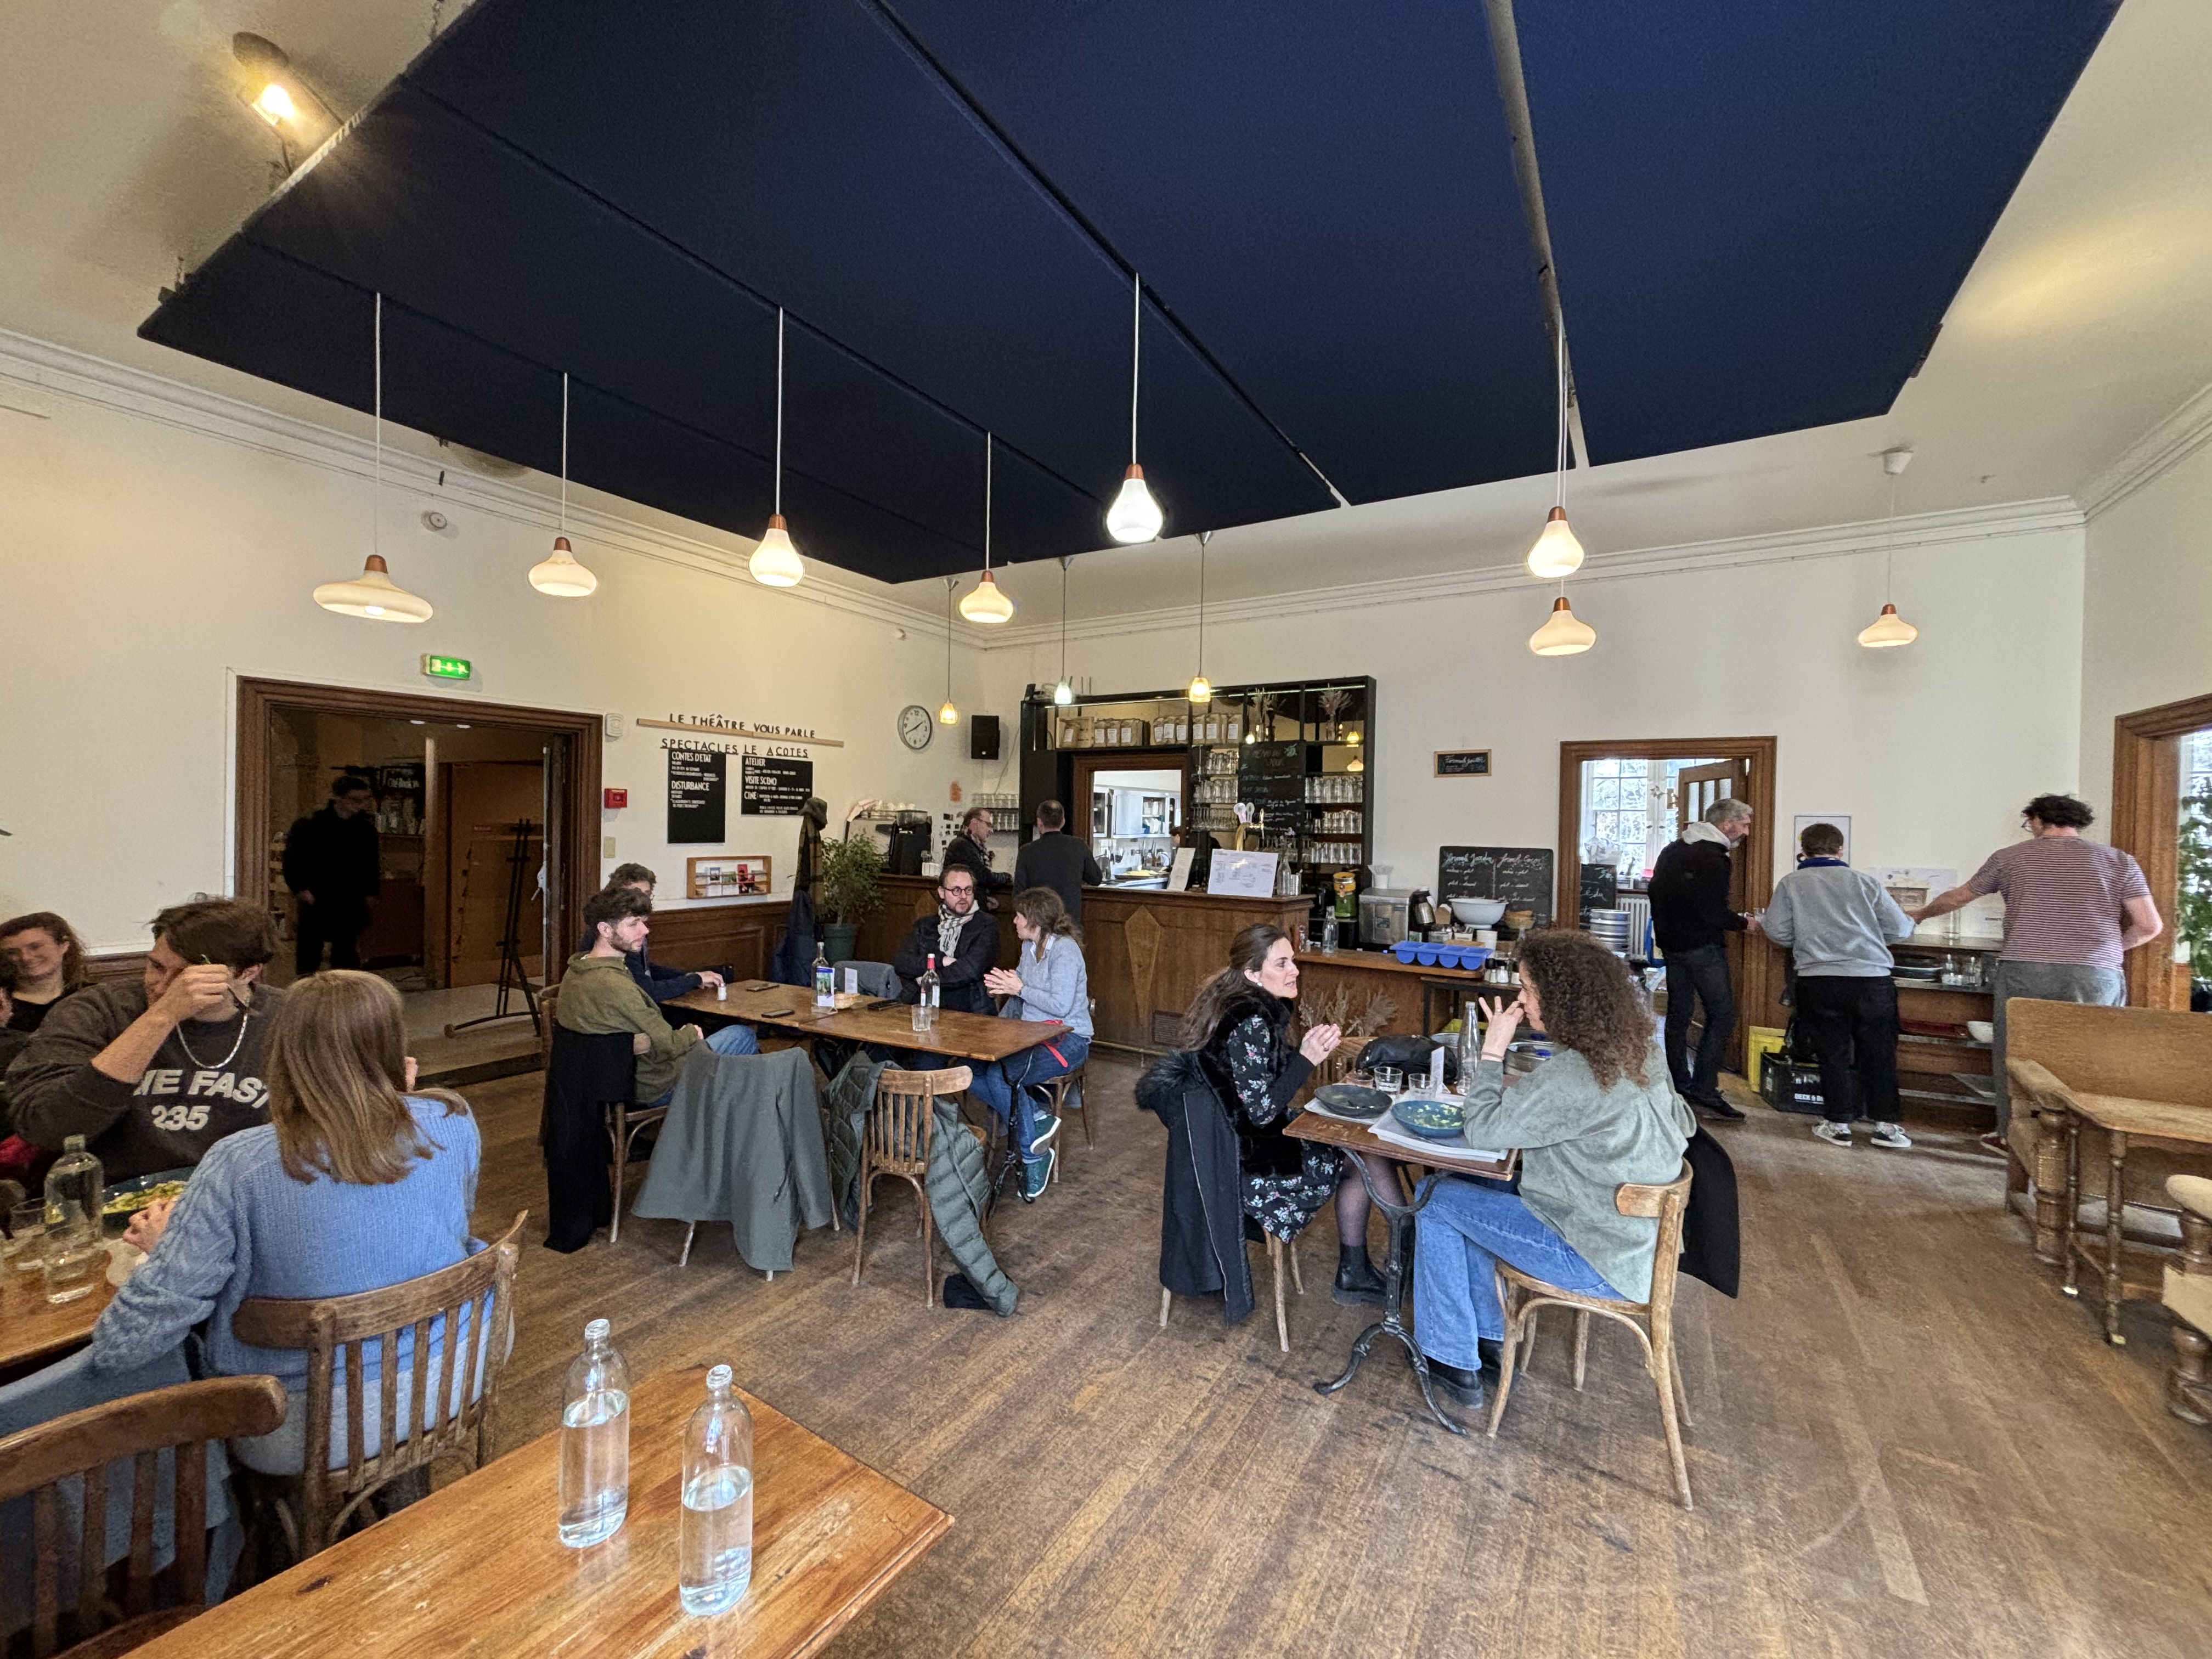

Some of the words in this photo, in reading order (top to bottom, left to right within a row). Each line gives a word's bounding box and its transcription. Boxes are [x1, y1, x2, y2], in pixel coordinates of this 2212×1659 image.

[670, 713, 684, 724] LE
[691, 714, 744, 731] THÉÂTRE
[753, 723, 780, 735] VOUS
[785, 727, 815, 738] PARLE
[661, 738, 738, 755] SPECTACLES
[672, 752, 693, 761] CONTES
[745, 757, 765, 766] ATELIER
[745, 775, 759, 784] VISITE
[672, 780, 709, 791] DISTURBANCE
[151, 1105, 211, 1131] 235
